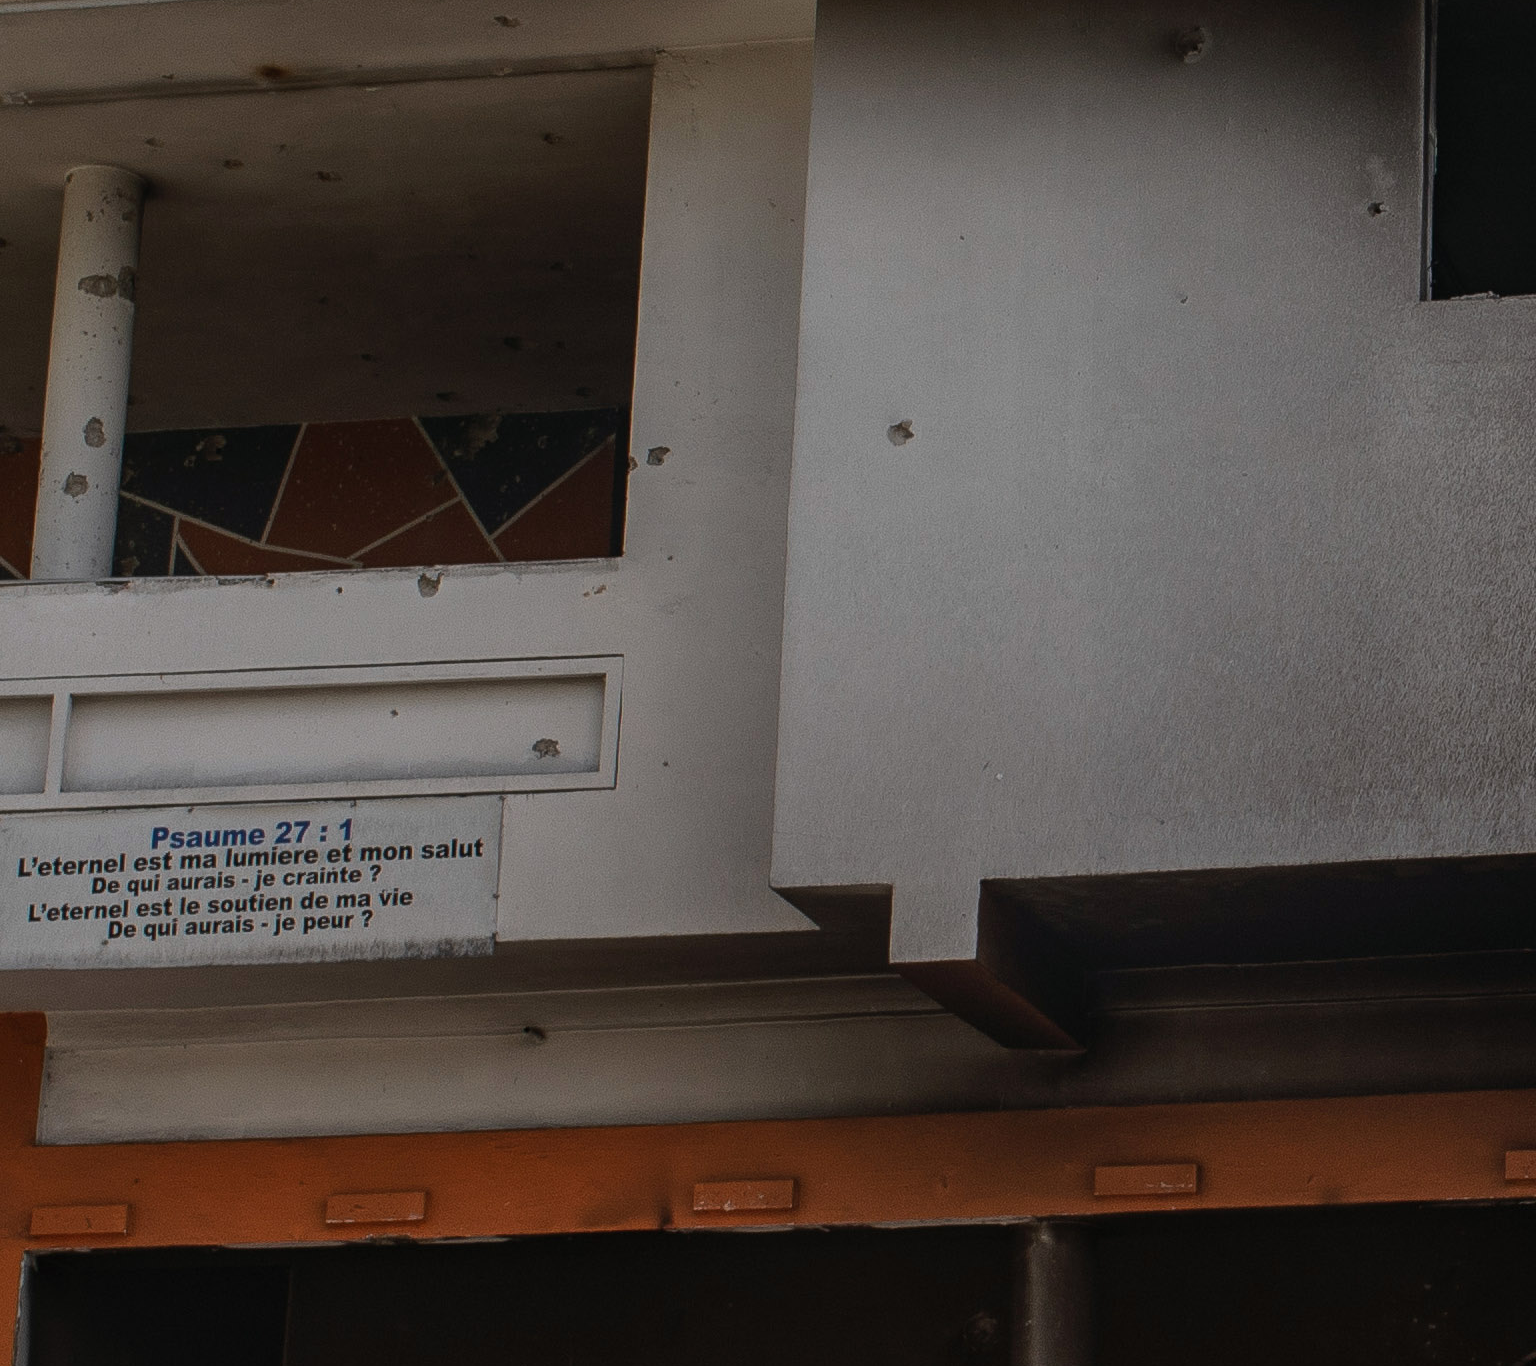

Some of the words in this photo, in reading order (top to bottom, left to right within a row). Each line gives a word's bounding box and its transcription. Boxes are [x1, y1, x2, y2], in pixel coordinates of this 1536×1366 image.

[151, 825, 265, 850] Psaume
[274, 820, 311, 845] 27
[319, 825, 328, 843] :
[339, 818, 353, 841] 1
[17, 852, 127, 878] L'eternel
[133, 850, 173, 872] est
[179, 852, 217, 870] ma
[225, 845, 319, 868] lumiere
[326, 843, 353, 864] et
[360, 844, 413, 862] mon
[421, 836, 484, 860] salut
[91, 876, 121, 895] De
[127, 873, 161, 897] qui
[167, 870, 236, 892] aurais
[253, 869, 276, 892] je
[282, 866, 363, 886] crainte
[369, 864, 382, 883] ?
[28, 899, 129, 923] L'eternel
[136, 897, 174, 918] est
[179, 896, 201, 916] le
[207, 893, 293, 915] soutien
[299, 891, 329, 910] de
[336, 891, 372, 909] ma
[379, 888, 414, 907] vie
[108, 920, 137, 940] De
[143, 917, 179, 941] qui
[185, 915, 255, 936] aurais
[273, 913, 296, 936] je
[302, 912, 354, 935] peur
[361, 909, 374, 928] ?
